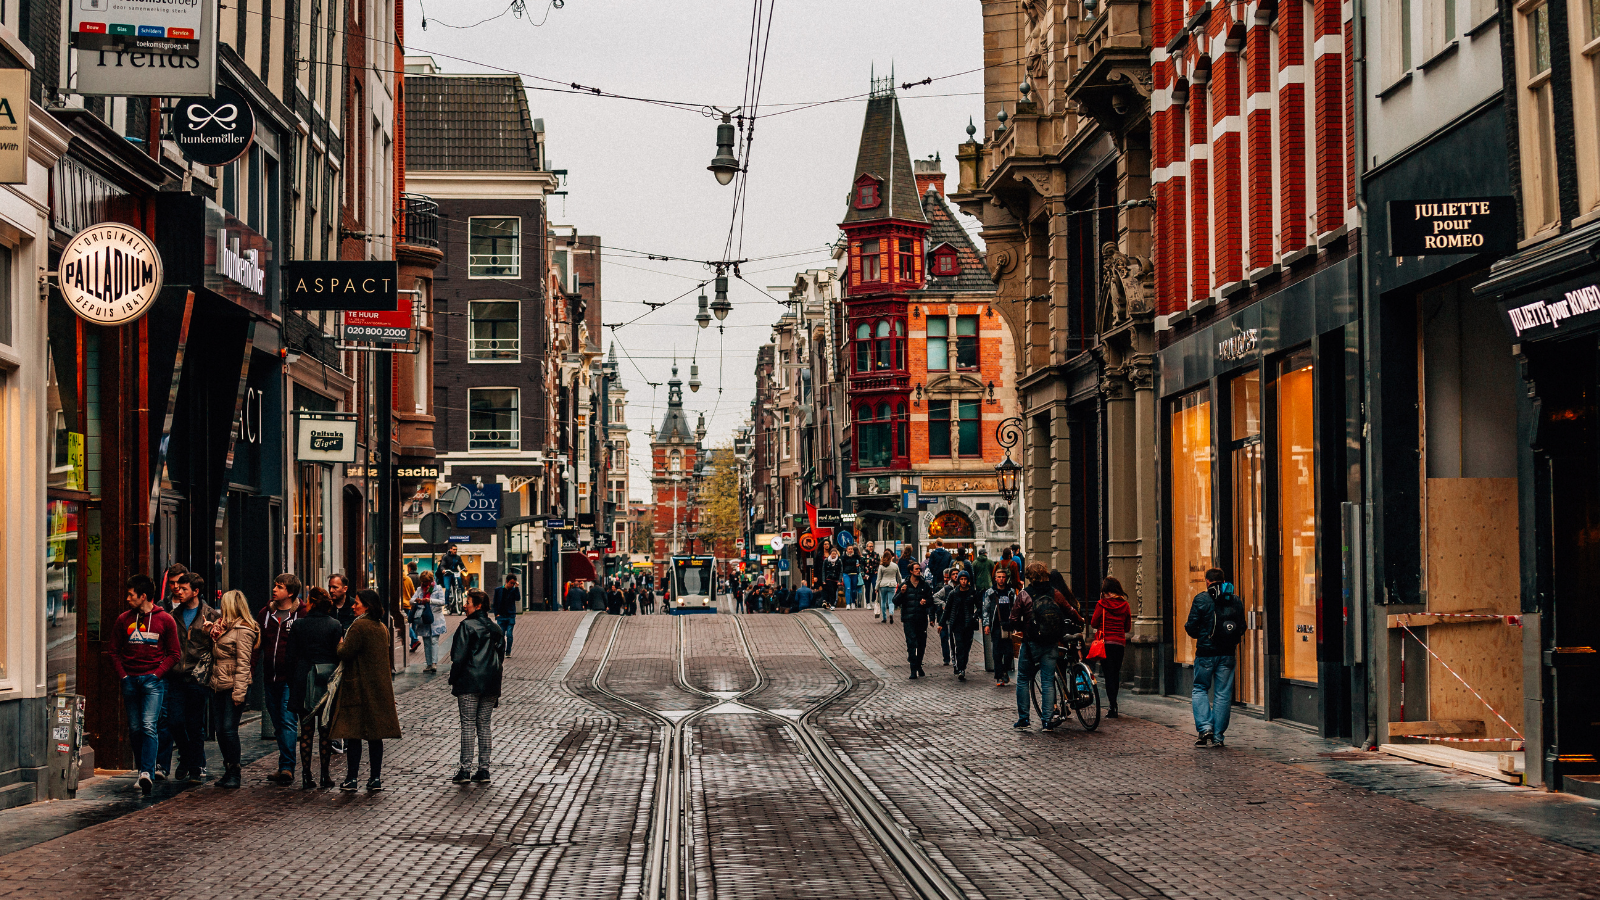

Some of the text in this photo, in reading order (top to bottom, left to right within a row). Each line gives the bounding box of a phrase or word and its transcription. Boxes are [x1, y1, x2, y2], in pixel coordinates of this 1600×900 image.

[137, 41, 190, 50] toekomstgroep.nl
[180, 133, 244, 144] hunkemöller
[1415, 202, 1490, 220] JULIETTE
[1433, 219, 1472, 234] pour
[74, 231, 146, 256] L'ORIGINALE
[1425, 234, 1484, 249] ROMEO
[66, 246, 152, 303] PALLADIUM
[295, 278, 391, 293] ASPACT
[76, 294, 144, 317] DEPUIS 1947
[1508, 284, 1600, 337] JULIETTE pour ROMEO
[347, 326, 407, 336] 020 800 2000
[314, 438, 339, 448] Tiger
[397, 466, 438, 477] sacha
[468, 499, 497, 509] ODY
[460, 513, 497, 521] SOX
